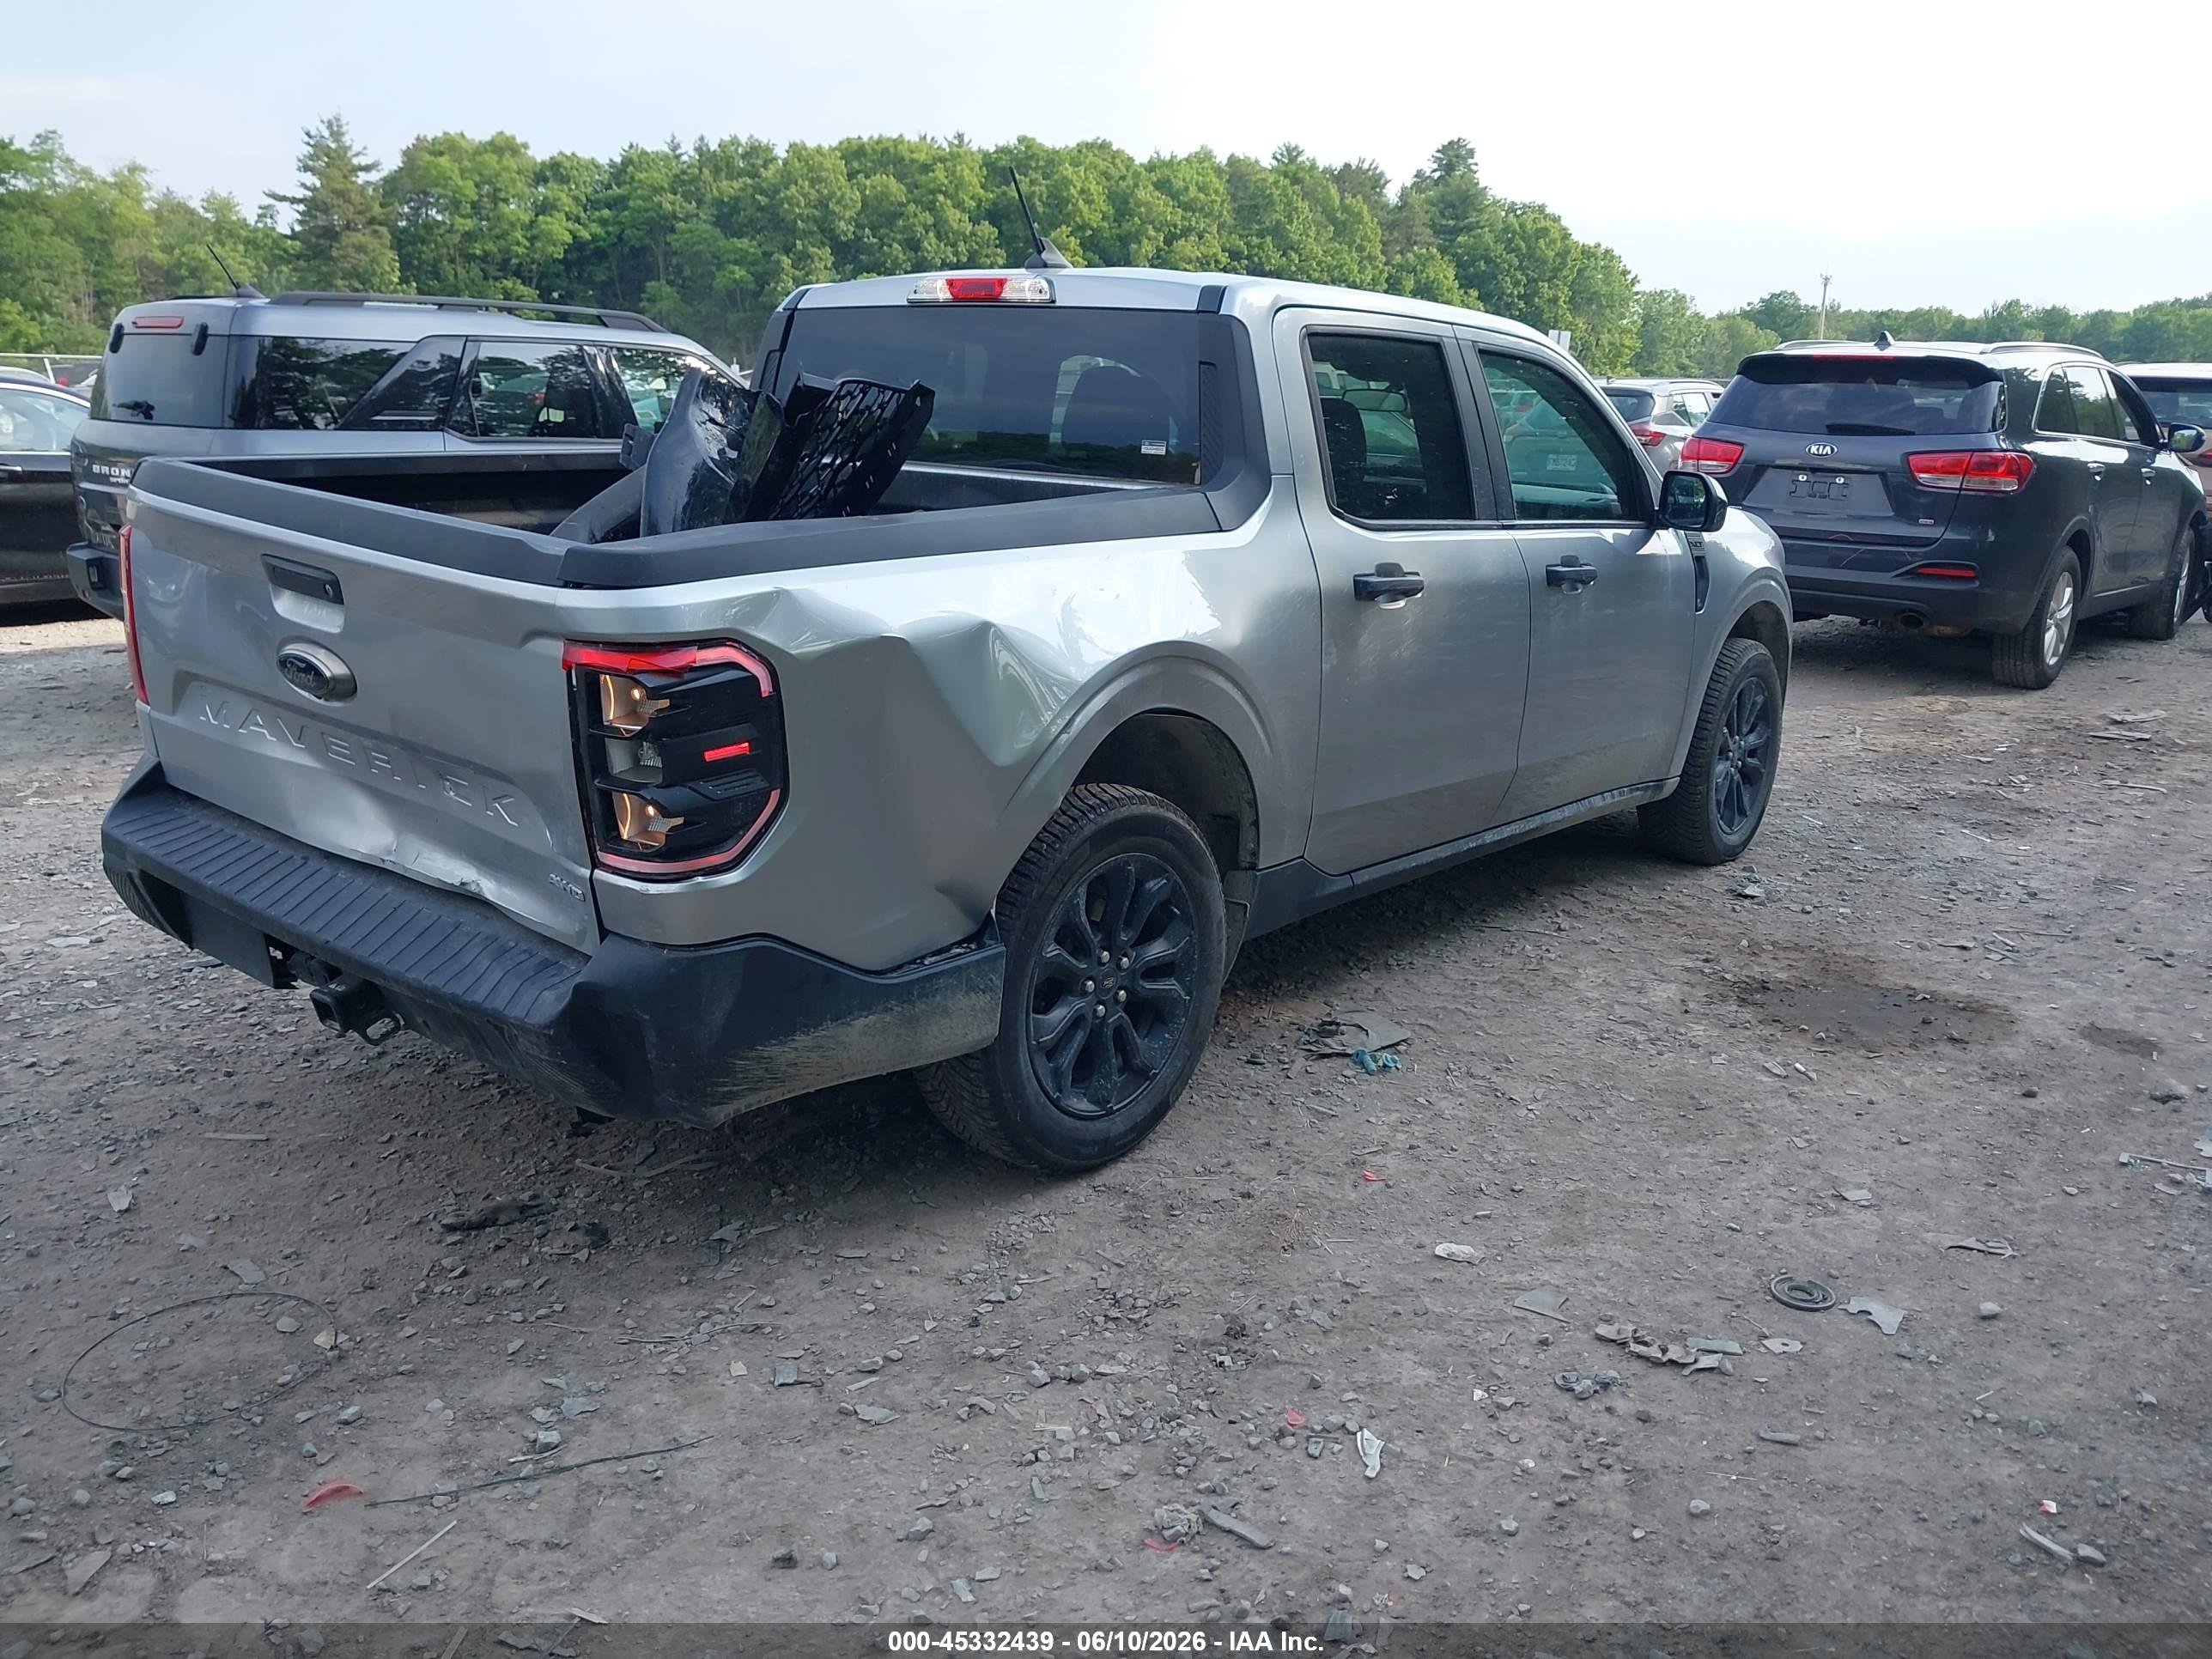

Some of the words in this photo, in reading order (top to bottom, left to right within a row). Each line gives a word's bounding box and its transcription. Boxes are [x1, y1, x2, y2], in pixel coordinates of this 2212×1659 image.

[1810, 445, 1832, 455] KIA
[92, 465, 135, 478] BRON
[199, 700, 519, 827] MAVERICK
